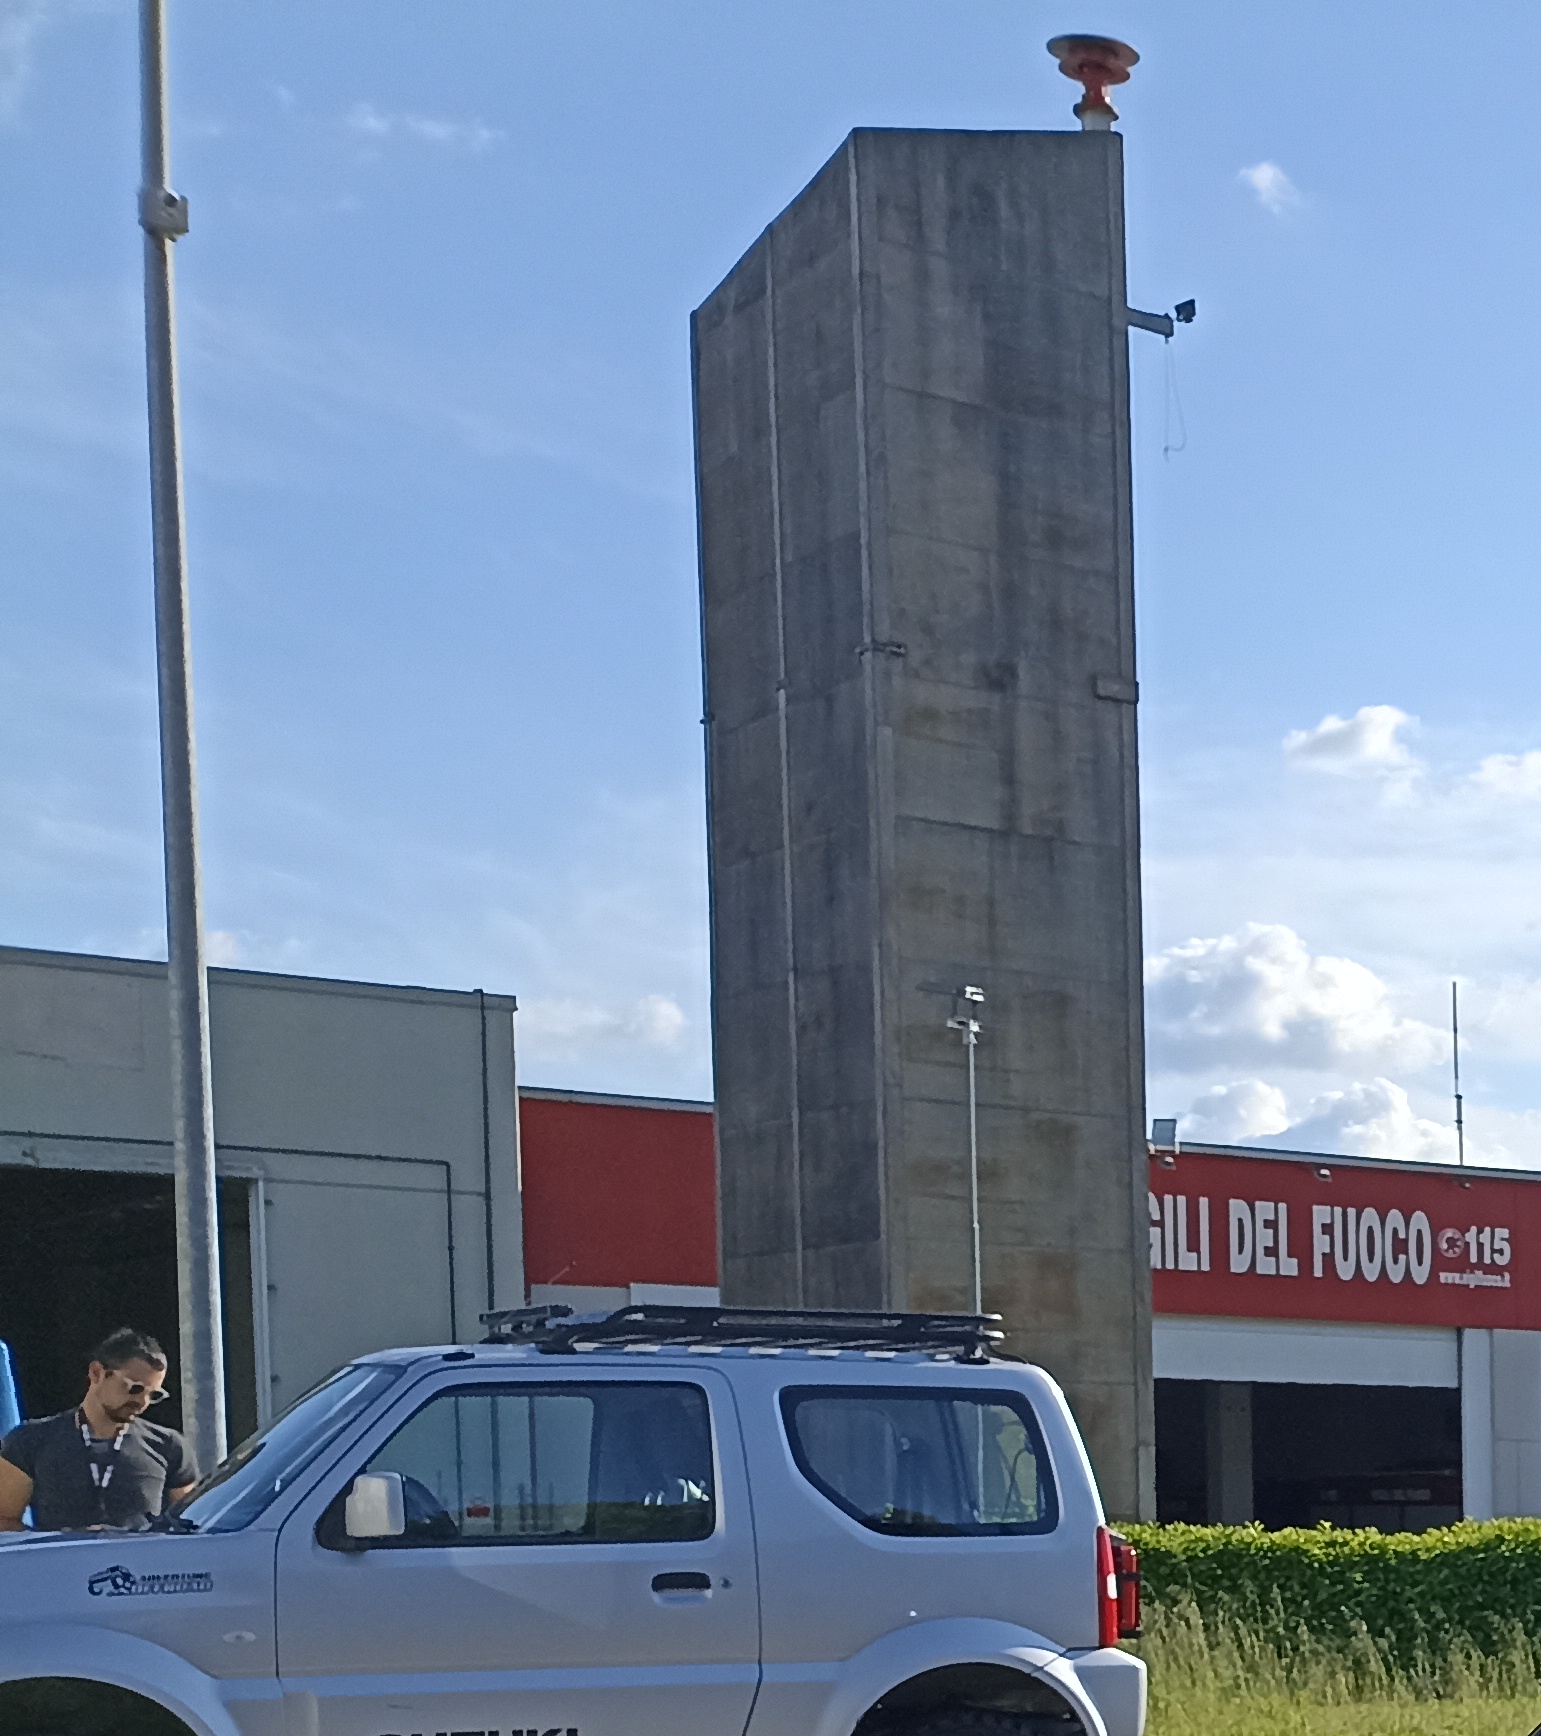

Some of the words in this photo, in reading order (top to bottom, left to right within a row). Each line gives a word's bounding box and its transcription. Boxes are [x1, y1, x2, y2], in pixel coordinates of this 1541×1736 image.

[1229, 1198, 1299, 1276] DEL
[1312, 1205, 1432, 1285] FUOCO
[1464, 1225, 1511, 1265] 115
